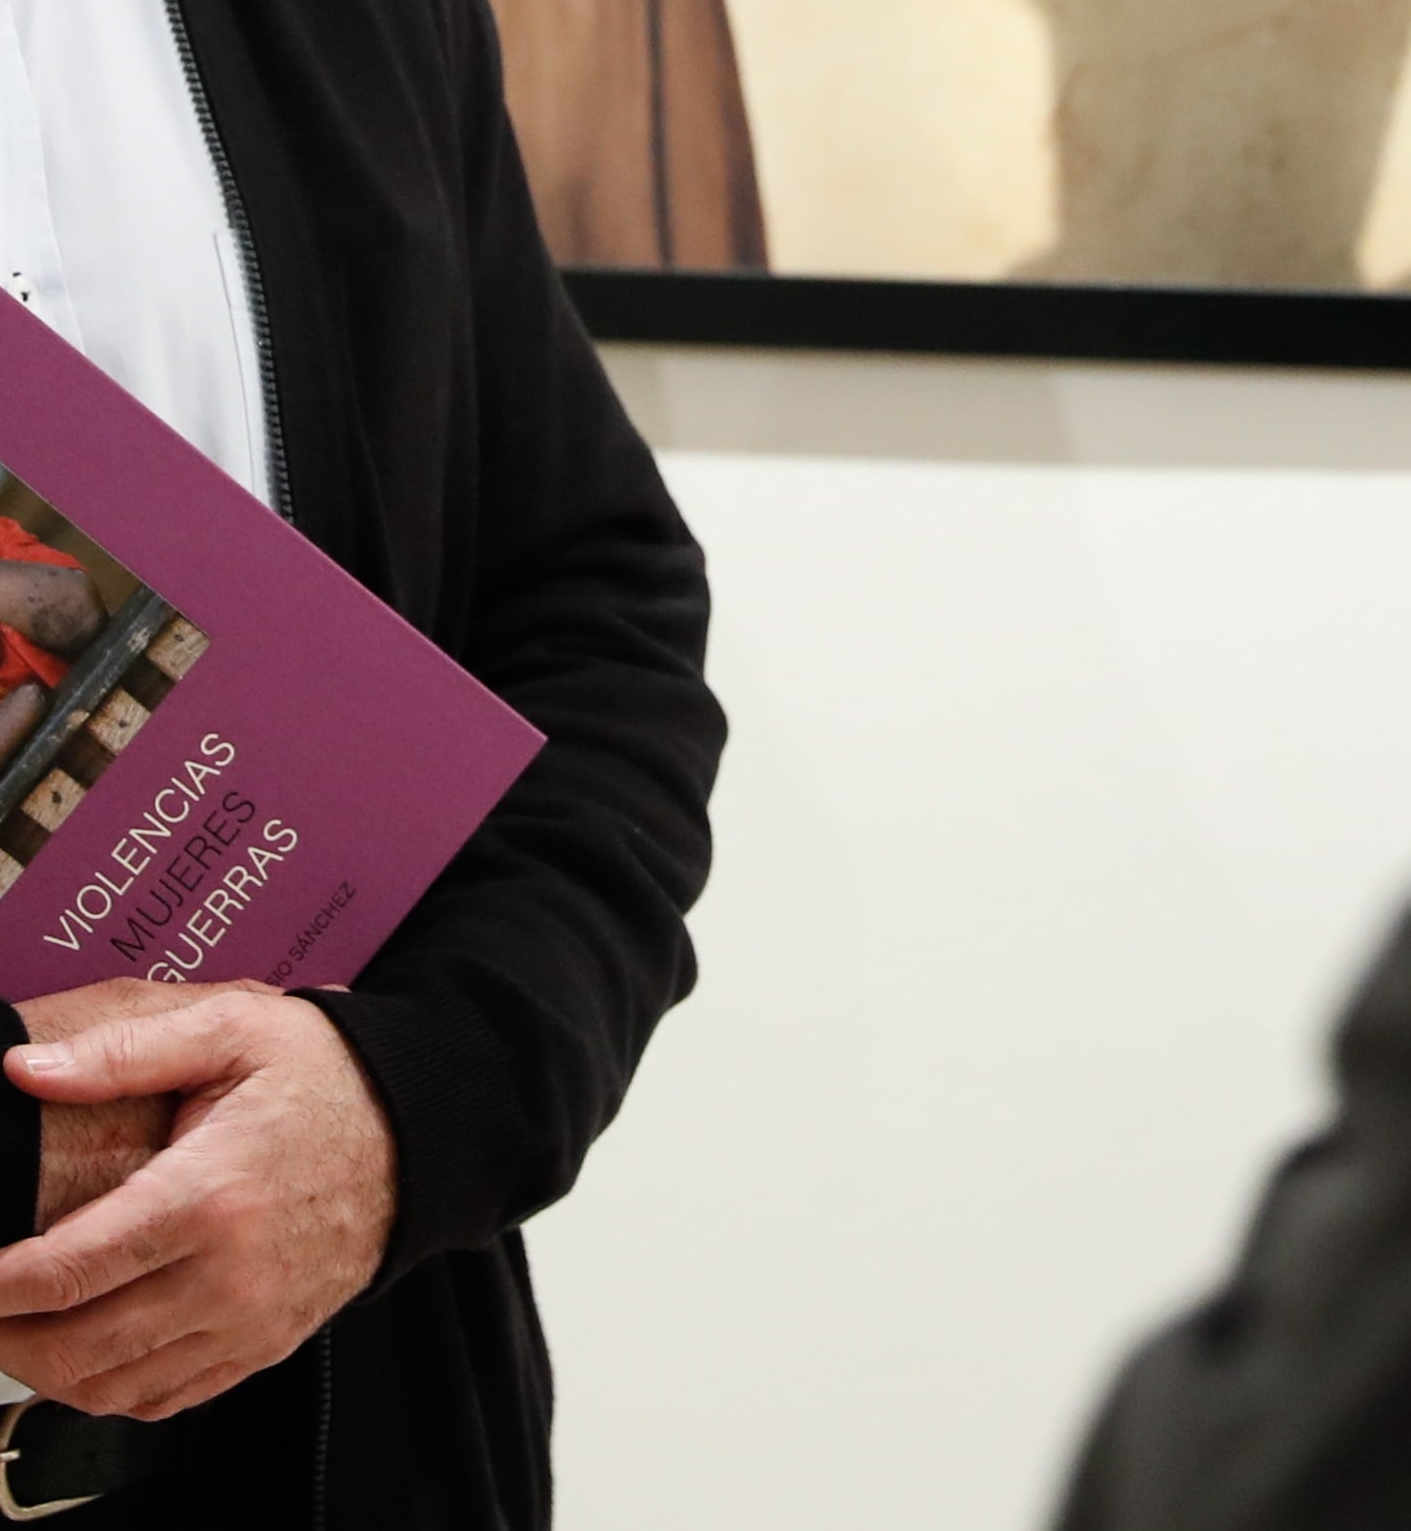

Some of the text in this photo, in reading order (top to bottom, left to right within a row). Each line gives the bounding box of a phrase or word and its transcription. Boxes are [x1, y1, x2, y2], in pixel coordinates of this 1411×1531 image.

[43, 733, 236, 951] VIOLENCIAS
[110, 790, 256, 962] MUJERES
[147, 818, 298, 983] GUERRAS
[288, 880, 356, 961] SÁNCHEZ
